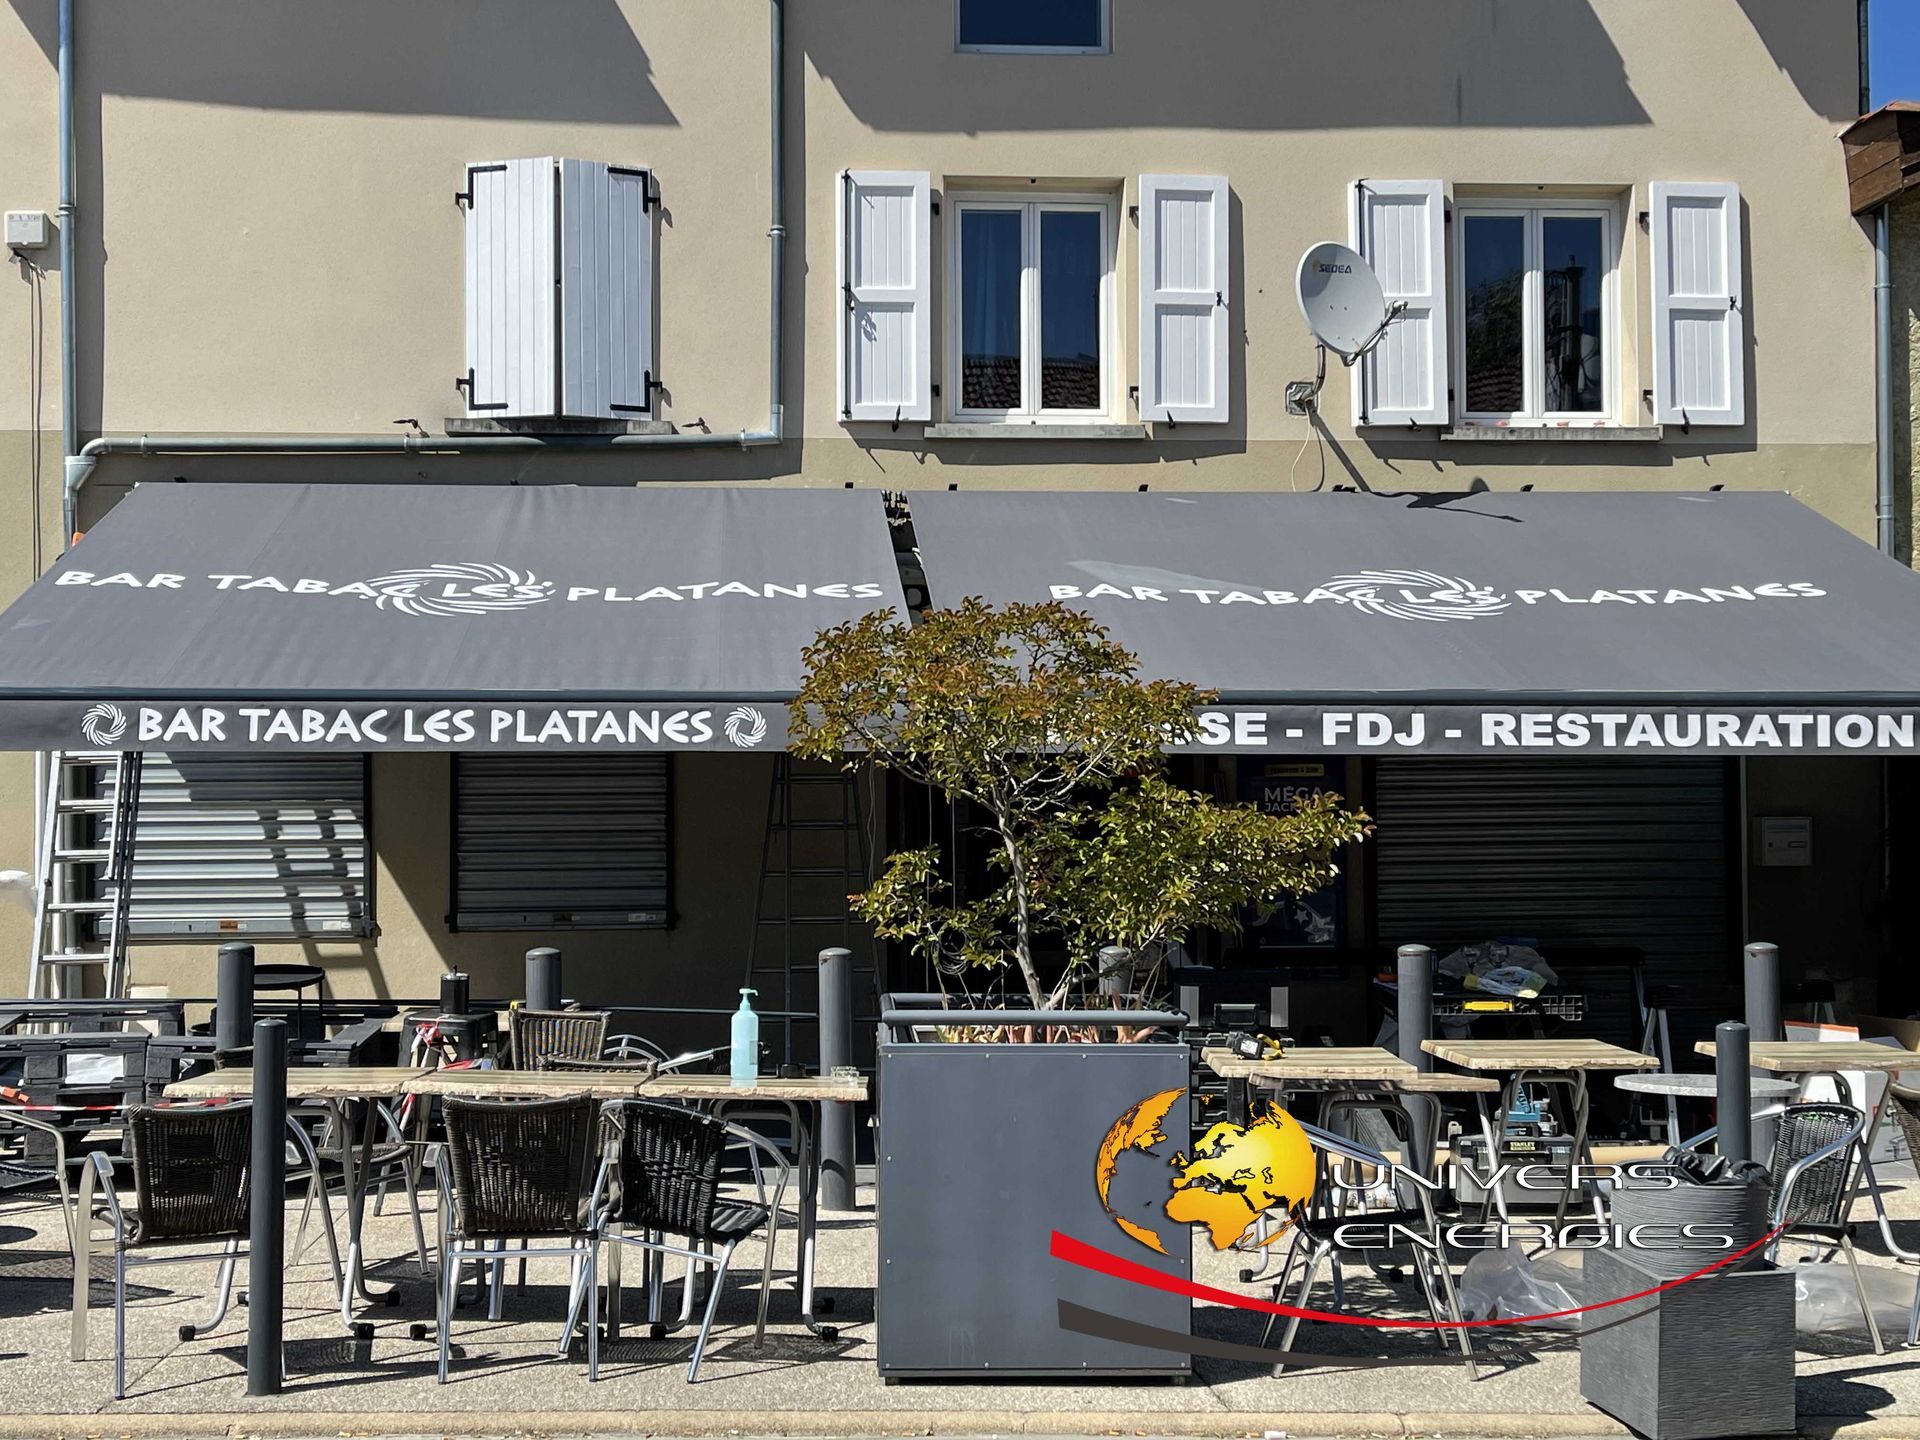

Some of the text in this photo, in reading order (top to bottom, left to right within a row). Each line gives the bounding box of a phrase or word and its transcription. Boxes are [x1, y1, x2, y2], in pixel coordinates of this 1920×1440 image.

[1319, 263, 1352, 273] SEDEA
[54, 570, 884, 601] BAR TABAC LES PLATANES
[1049, 582, 1827, 605] BAR TABAC LES PLATANES
[138, 707, 713, 744] BAR TABAC LES PLATANES
[1322, 712, 1425, 747] FDJ
[1481, 713, 1914, 748] RESTAURATION
